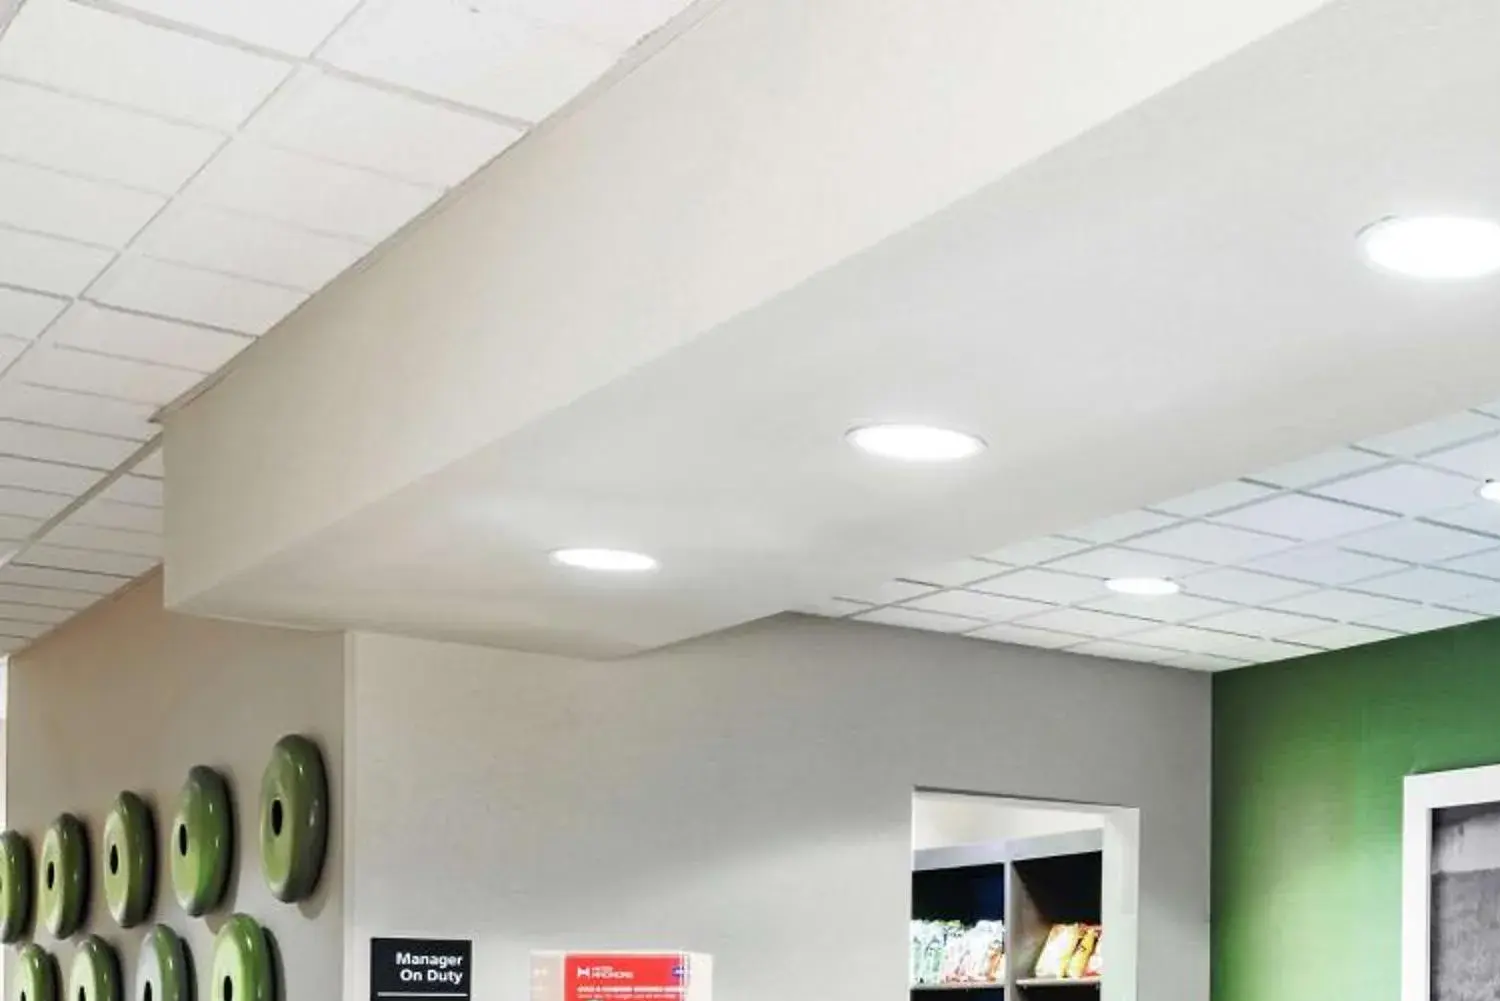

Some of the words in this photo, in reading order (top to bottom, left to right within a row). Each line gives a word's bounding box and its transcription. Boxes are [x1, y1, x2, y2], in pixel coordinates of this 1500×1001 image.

[395, 952, 464, 969] Manager
[400, 969, 423, 982] On
[427, 969, 463, 985] Duty
